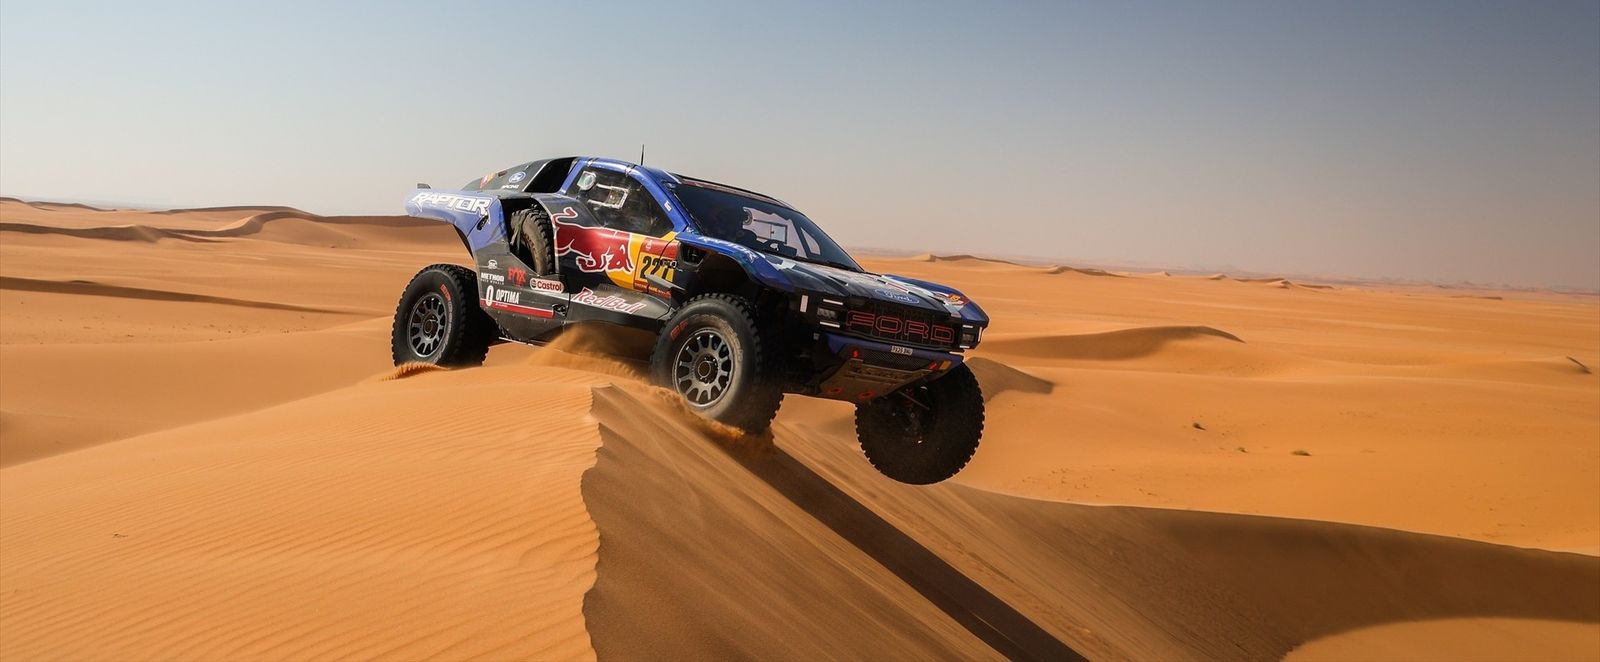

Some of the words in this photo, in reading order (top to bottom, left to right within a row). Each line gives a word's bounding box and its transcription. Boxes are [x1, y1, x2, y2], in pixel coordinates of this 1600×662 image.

[411, 192, 491, 222] RAPTOR
[480, 271, 505, 282] METHOD
[536, 280, 562, 291] Castrol
[495, 288, 520, 305] OPTIMA
[846, 310, 955, 345] FORD
